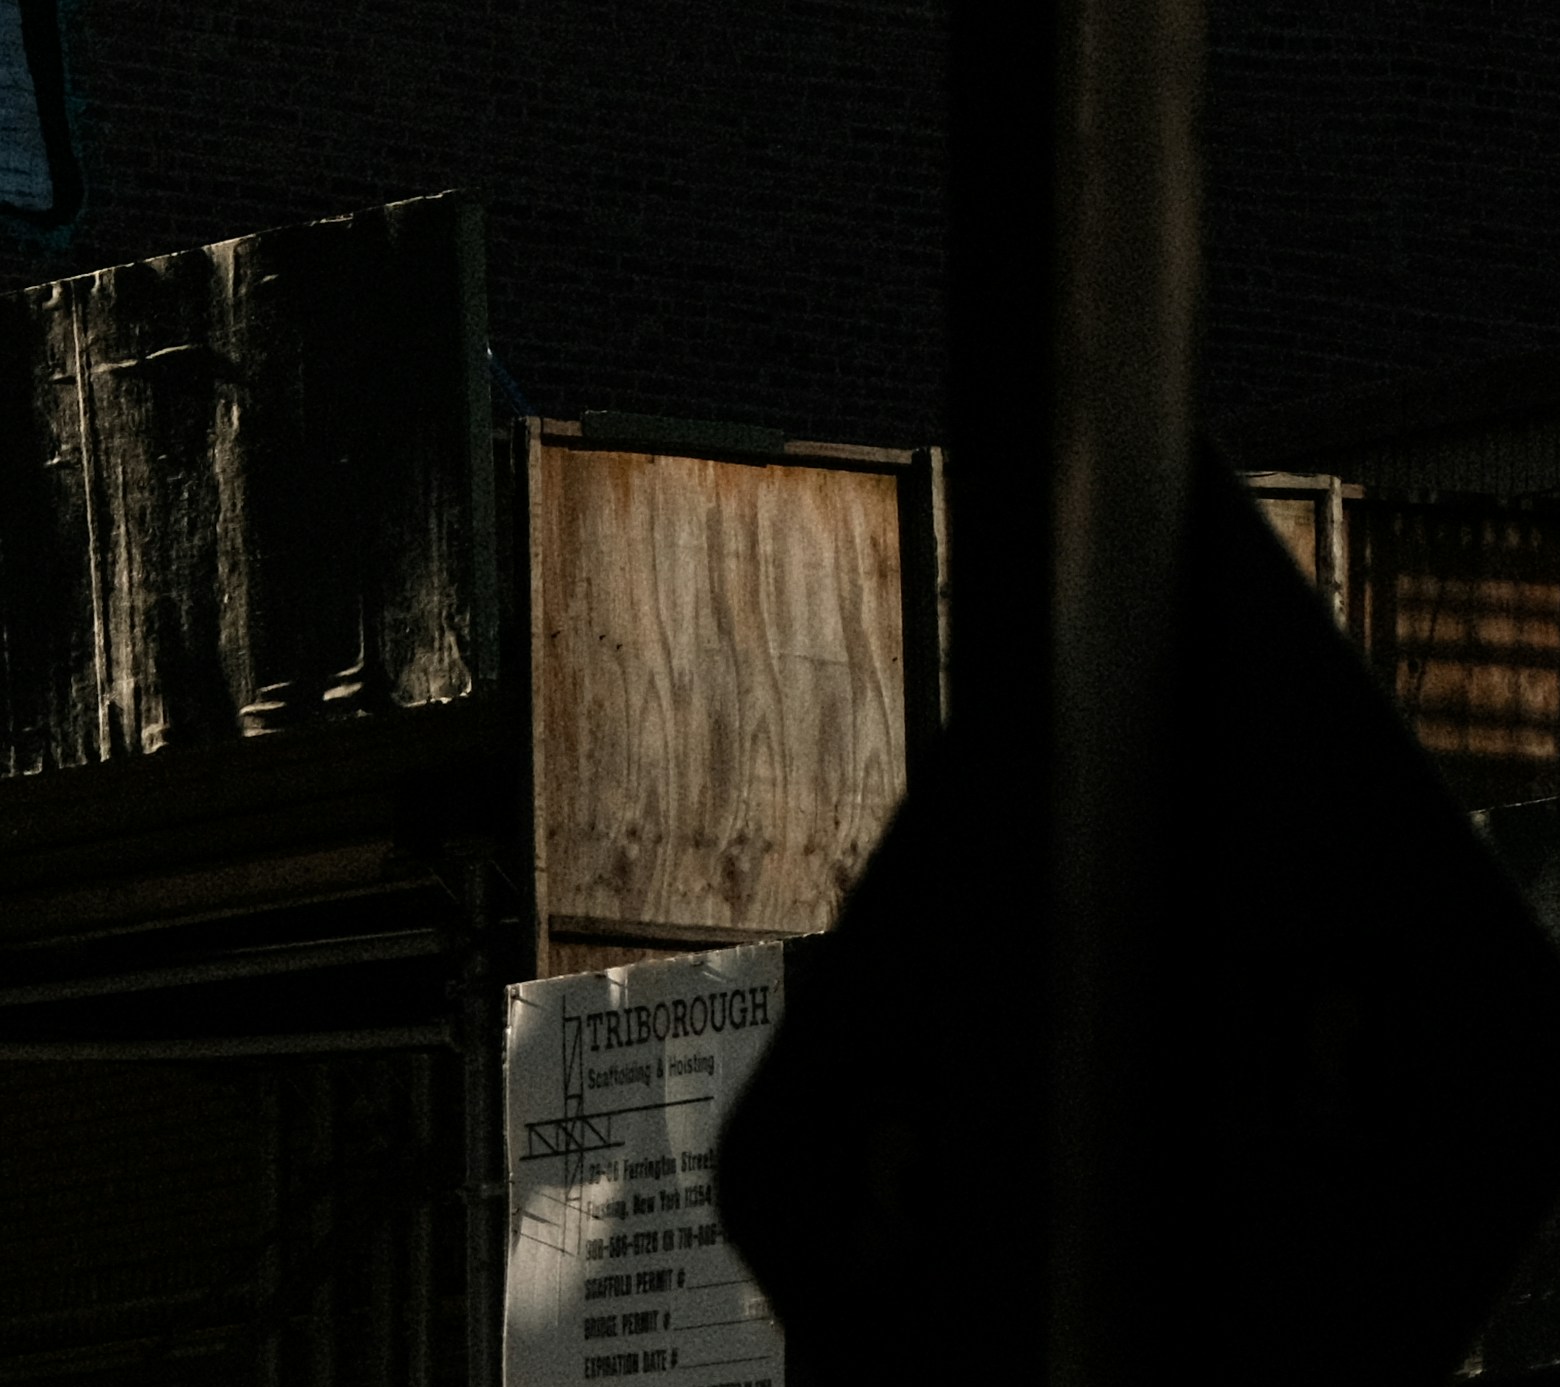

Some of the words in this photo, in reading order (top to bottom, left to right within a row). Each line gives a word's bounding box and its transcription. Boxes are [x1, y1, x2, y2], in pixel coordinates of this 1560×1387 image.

[587, 986, 770, 1051] TRIBOROUGH
[587, 1061, 650, 1089] Scaffolding
[669, 1054, 715, 1077] Hoisting
[585, 1275, 632, 1300] SCAFFOLD
[636, 1269, 673, 1295] PERMIT
[622, 1310, 658, 1336] PERMIT
[584, 1353, 639, 1379] EXPIRATION
[643, 1349, 667, 1373] DATE
